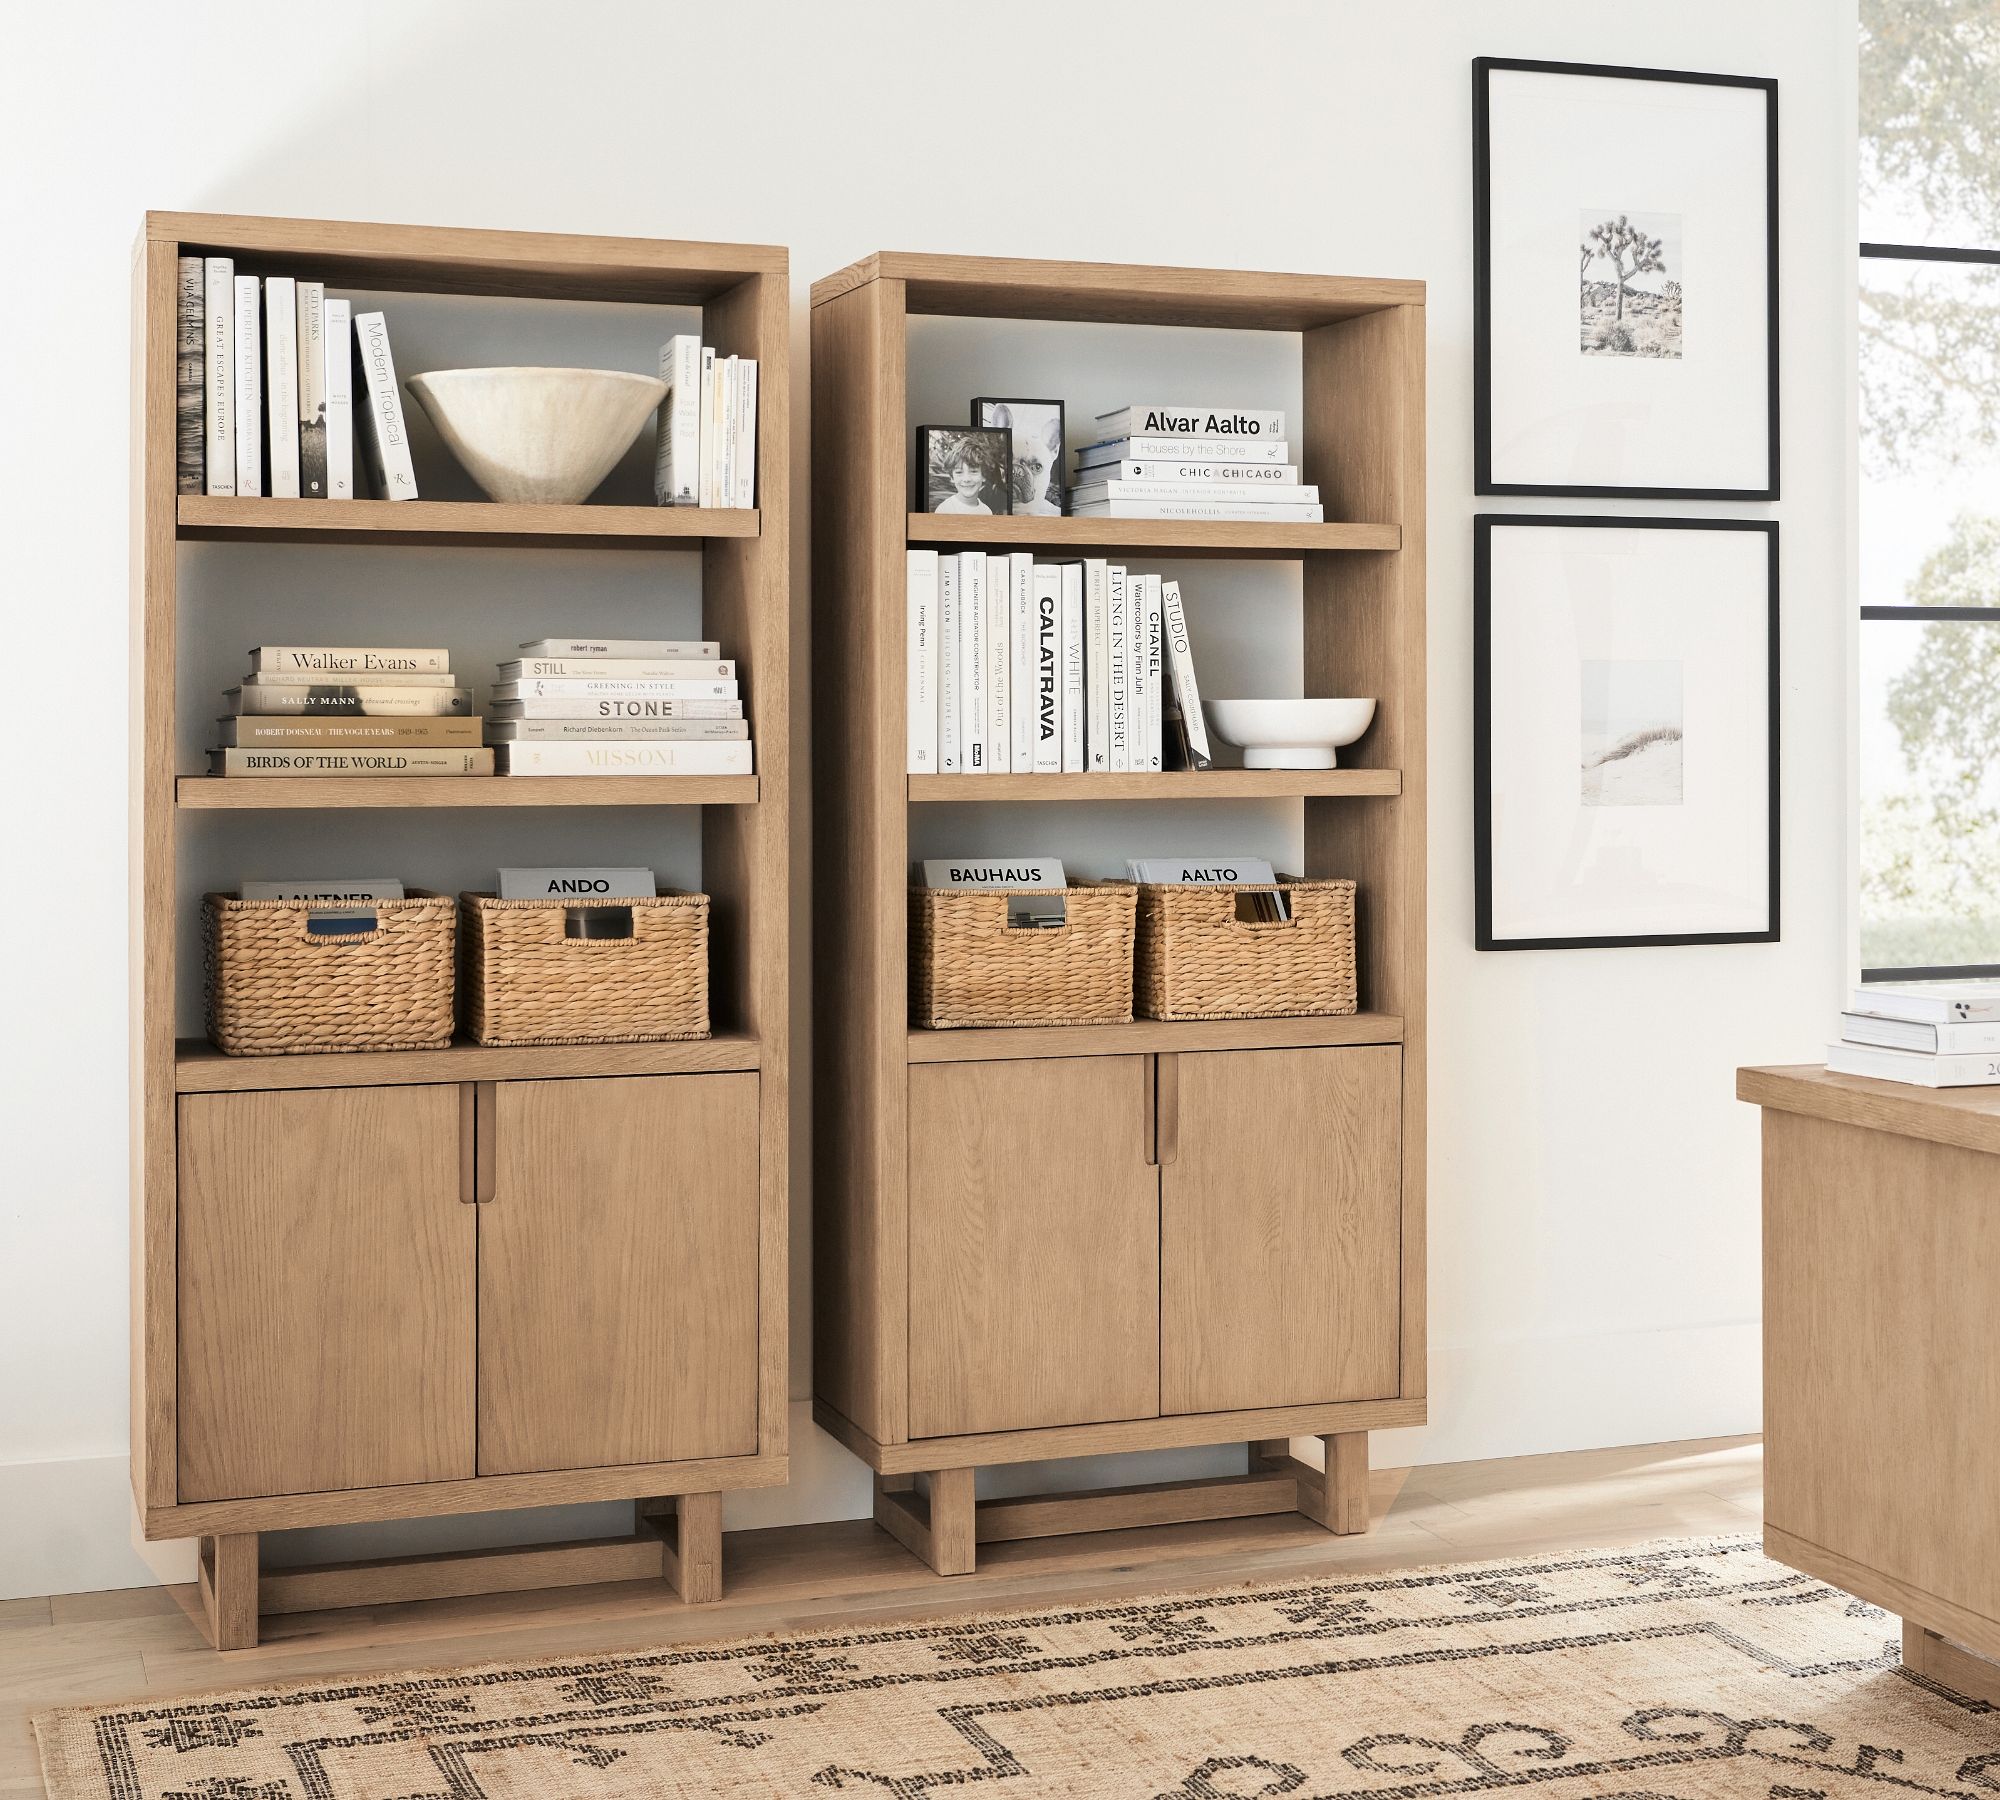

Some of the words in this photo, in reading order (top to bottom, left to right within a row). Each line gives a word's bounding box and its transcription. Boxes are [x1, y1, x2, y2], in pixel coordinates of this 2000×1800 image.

[184, 278, 194, 298] VIJA
[311, 288, 319, 310] CITY
[216, 315, 224, 350] GREAT
[311, 313, 320, 341] PARKS
[216, 354, 225, 398] ESCAPES
[367, 322, 389, 382] Modern
[380, 388, 404, 446] Tropical
[217, 401, 226, 441] EUROPE
[1144, 411, 1199, 433] Alvar
[1204, 414, 1260, 435] Aalto
[1141, 442, 1180, 455] Houses
[1182, 443, 1195, 456] by
[1197, 443, 1213, 455] the
[1215, 444, 1246, 456] Shore
[1179, 467, 1211, 478] CHIC
[1222, 470, 1282, 479] CHICAGO
[1112, 571, 1122, 626] LIVING
[918, 605, 926, 627] Irving
[1134, 583, 1143, 640] Watercolors
[1165, 592, 1187, 654] STUDIO
[570, 644, 588, 652] robert
[590, 645, 608, 654] ryman
[1113, 631, 1123, 648] IN
[1134, 642, 1143, 653] by
[1150, 612, 1159, 677] CHANEL
[292, 653, 358, 670] Walker
[364, 654, 417, 670] Evans
[534, 662, 566, 675] STILL
[995, 642, 1004, 675] Woods
[1113, 652, 1124, 685] THE
[1135, 655, 1143, 675] Finn
[1040, 597, 1054, 741] CALATRAVA
[1069, 643, 1081, 695] WHITE
[995, 677, 1004, 692] the
[1135, 676, 1144, 695] Juhl
[1184, 674, 1192, 692] SALLY
[281, 697, 316, 705] SALLY
[599, 701, 673, 716] STONE
[995, 694, 1004, 705] of
[995, 707, 1004, 727] Out
[1114, 690, 1125, 751] DESERT
[255, 728, 285, 736] ROBERT
[286, 728, 323, 736] DOISNEAU
[328, 728, 343, 736] THE
[343, 728, 368, 736] VOGUE
[368, 728, 395, 736] YEARS
[246, 756, 291, 769] BIRDS
[293, 756, 314, 769] OF
[315, 756, 349, 769] THE
[351, 756, 407, 769] WORLD
[586, 750, 677, 767] MISSONI
[973, 744, 981, 766] MoMA
[950, 868, 1042, 882] BAUHAUS
[1181, 868, 1238, 881] AALTO
[547, 879, 610, 893] ANDO
